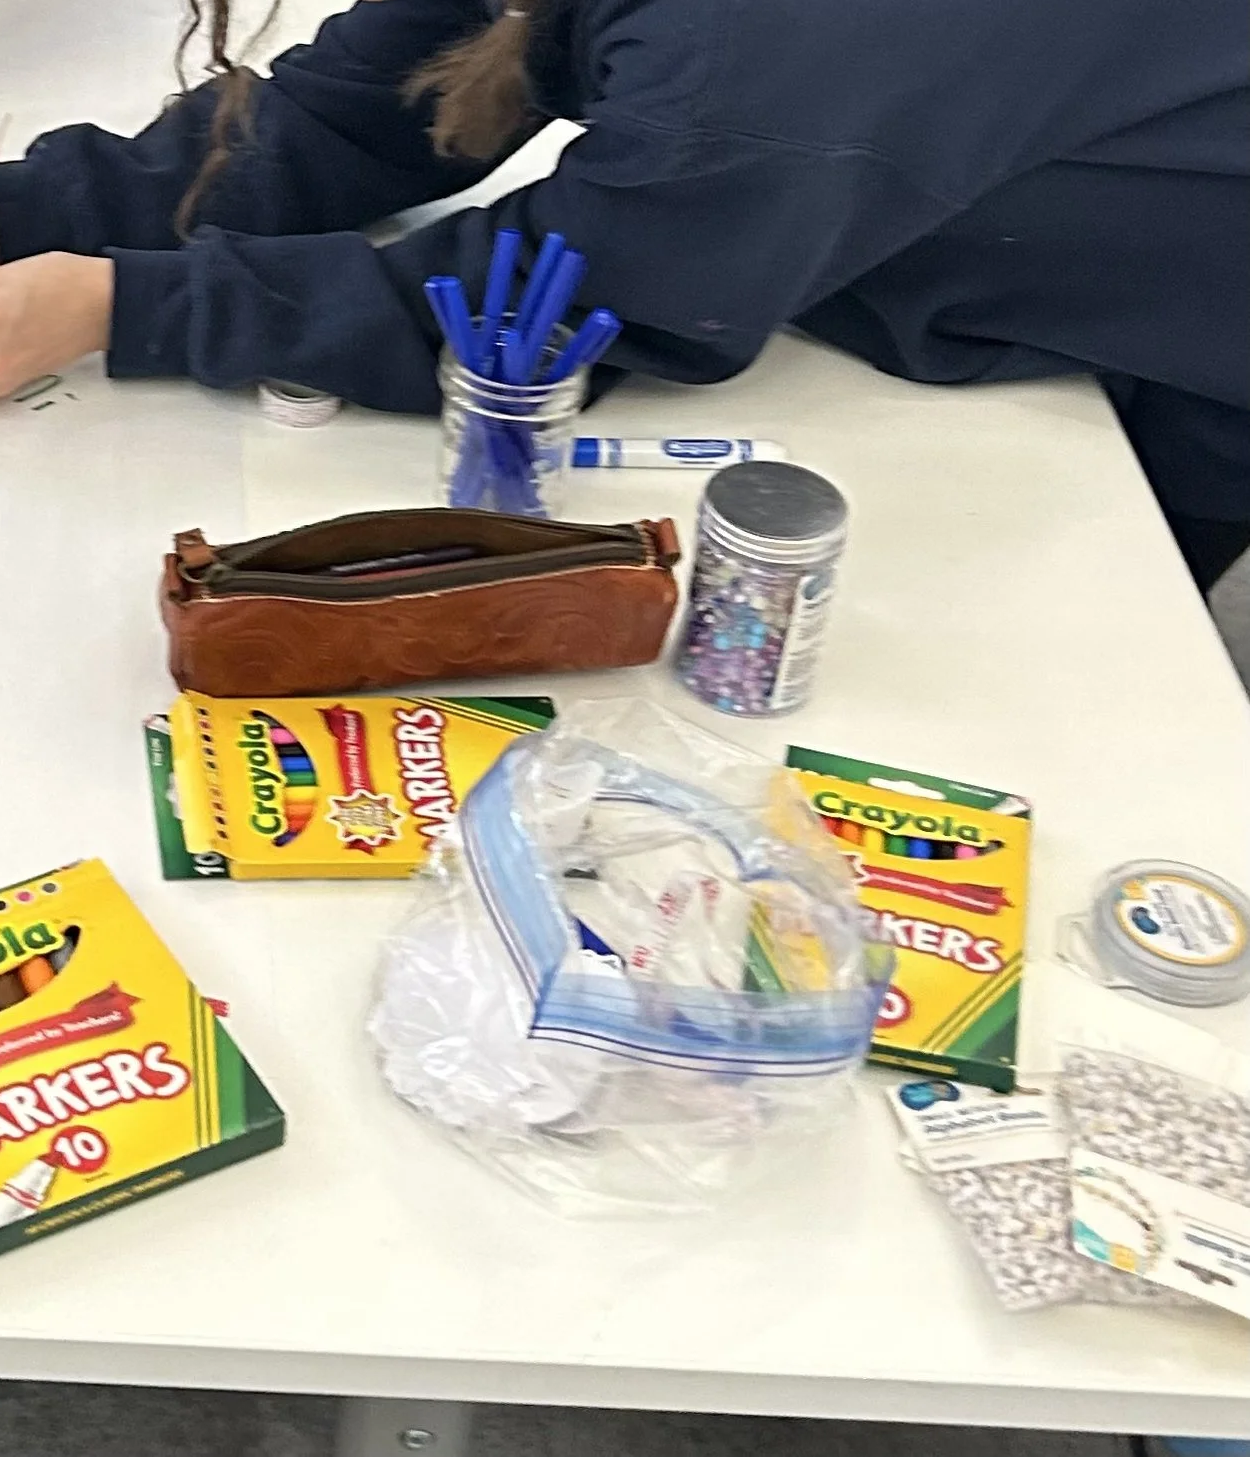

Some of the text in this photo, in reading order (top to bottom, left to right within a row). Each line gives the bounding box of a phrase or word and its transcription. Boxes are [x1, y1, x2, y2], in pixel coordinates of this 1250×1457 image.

[237, 723, 283, 835] Crayola
[812, 790, 982, 844] Crayola
[54, 1130, 103, 1167] 10
